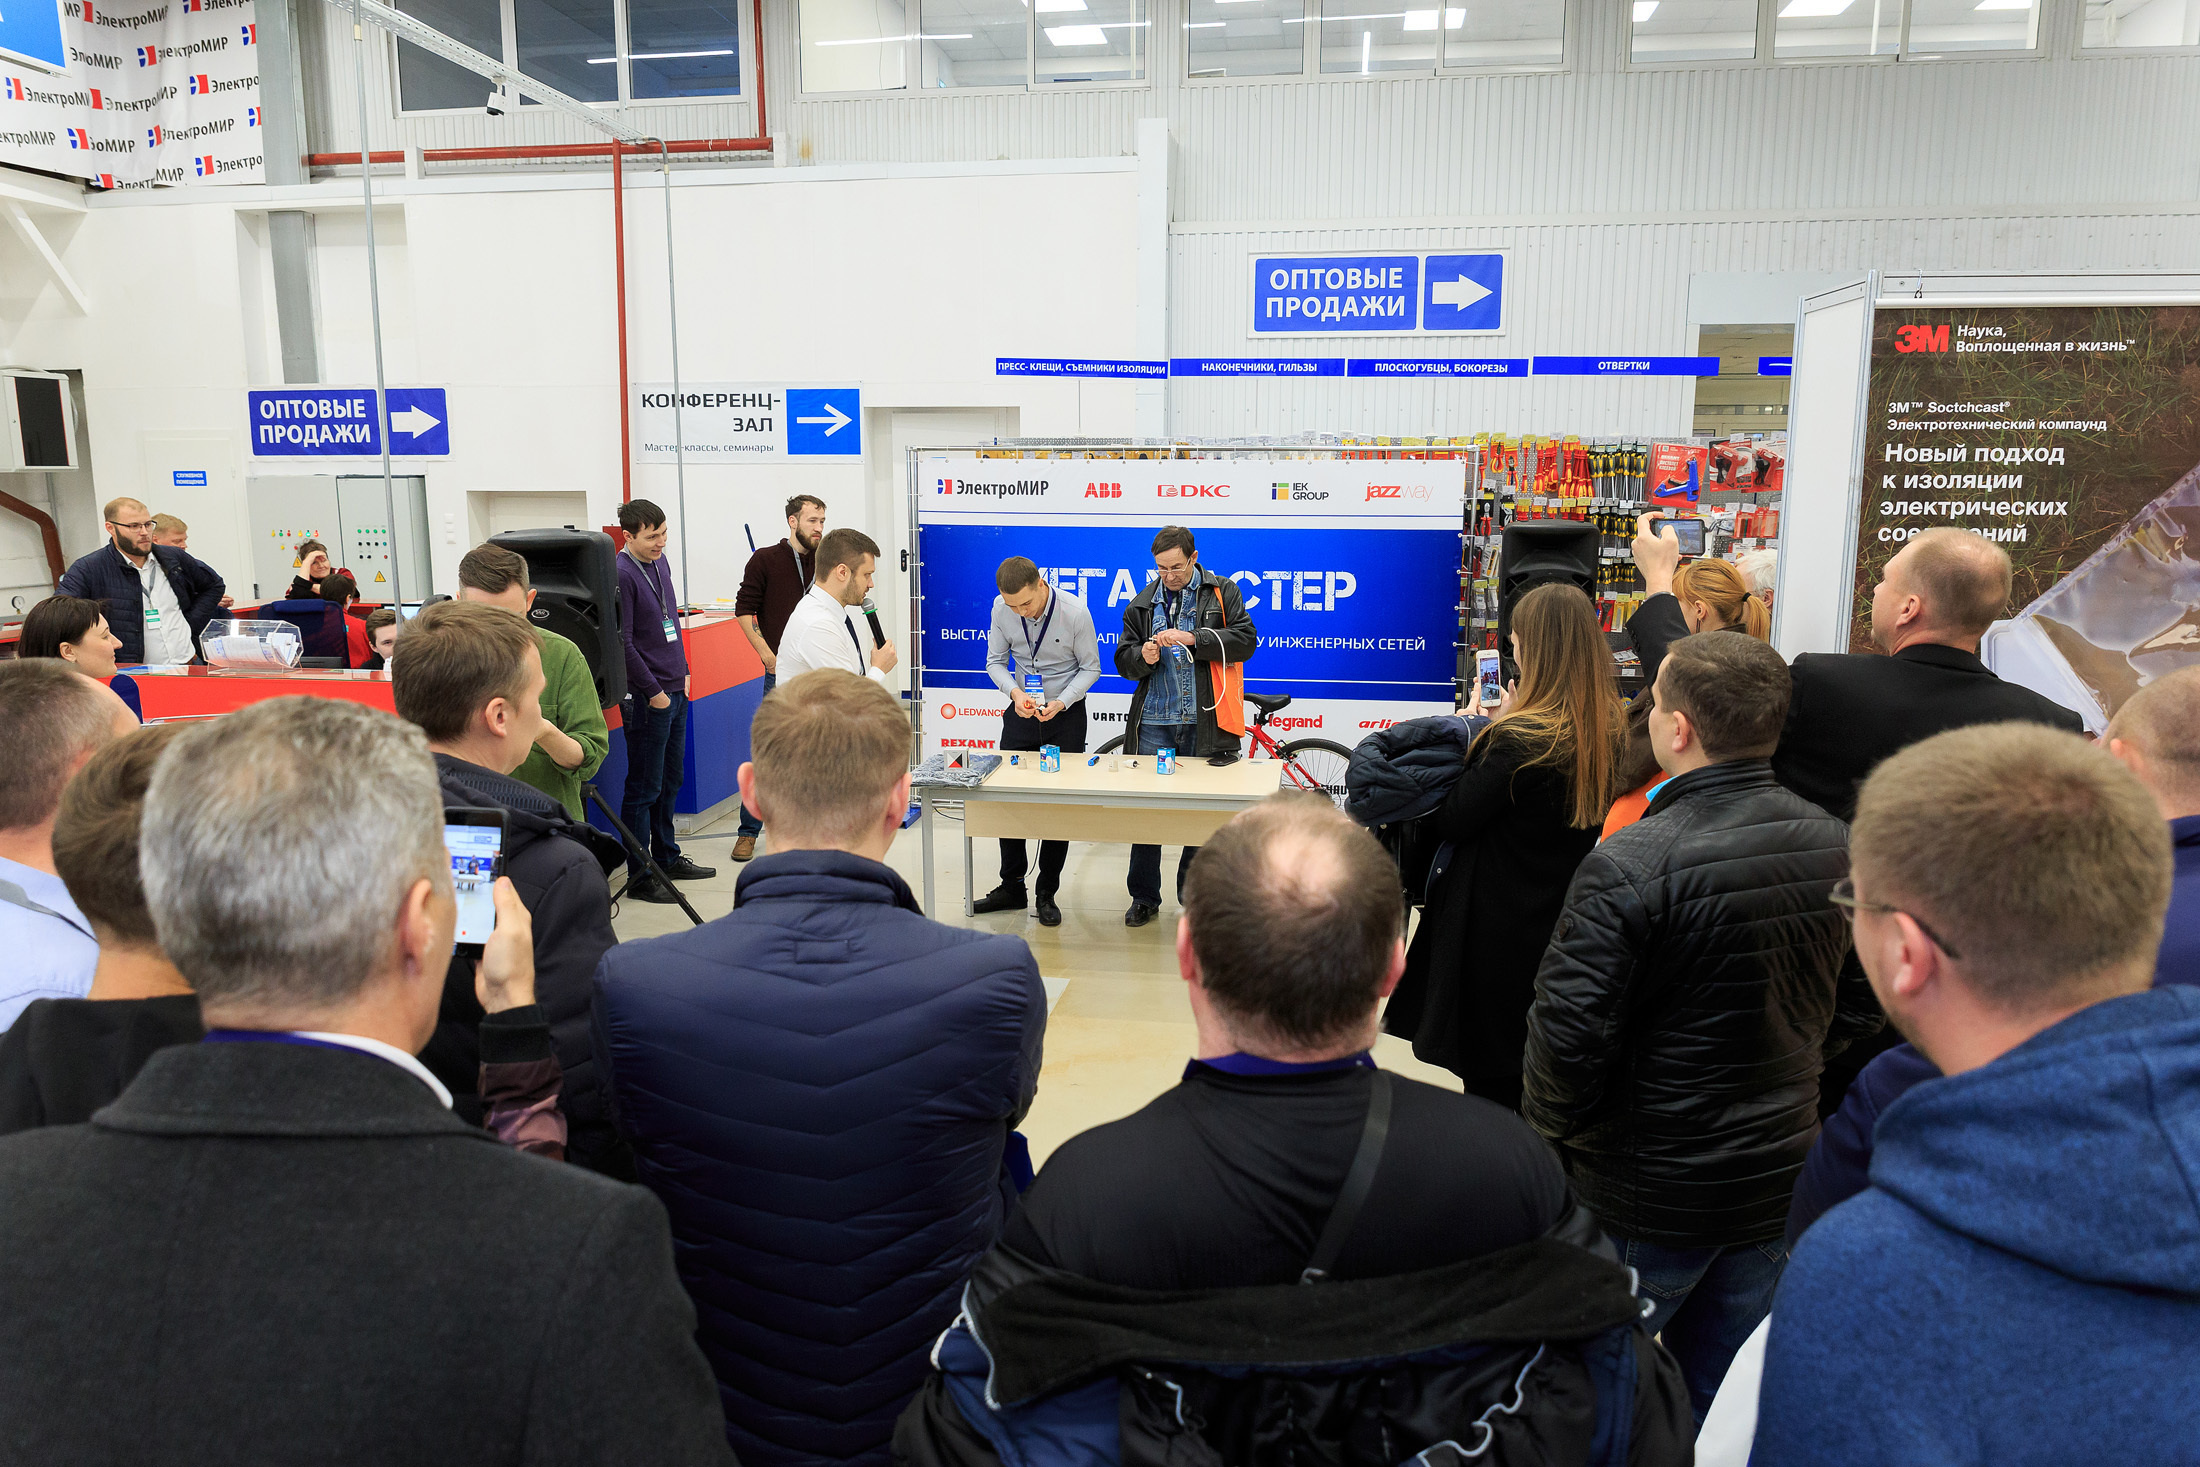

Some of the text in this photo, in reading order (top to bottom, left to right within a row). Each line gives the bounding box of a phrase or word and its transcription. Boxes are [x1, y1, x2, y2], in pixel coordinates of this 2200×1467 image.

[204, 0, 254, 11] Электр
[162, 118, 235, 141] ЭлектроМИР
[1269, 267, 1404, 291] ОПТОВЫЕ
[1266, 295, 1406, 322] ПРОДАЖИ
[1894, 324, 1950, 354] 3M
[1957, 324, 2008, 339] Наука,
[1955, 340, 2062, 354] Воплощенная
[2064, 342, 2074, 352] в
[998, 362, 1167, 375] ПРЕСС- КЛЕЩИ, СЪЕМНИКИ ИЗОЛЯЦИИ
[1201, 362, 1318, 374] НАКОНЕЧНИКИ, ГИЛЬЗЫ
[1374, 363, 1508, 374] ПЛОСКОГУБЦЫ, БОКОРЕЗЫ
[1598, 361, 1650, 371] ОТВЕРТКИ
[259, 398, 367, 420] ОПТОВЫЕ
[641, 392, 781, 411] КОНФЕРЕНЦ-
[732, 417, 774, 432] ЗАЛ
[1887, 418, 2108, 431] Электротехнический компаунд
[259, 424, 372, 448] ПРОДАЖИ
[644, 443, 774, 454] Мастер-классы, семинары
[1884, 443, 2066, 465] Новый подход
[956, 479, 1050, 499] ЭлектроМИР
[1084, 482, 1123, 499] ABB
[1180, 484, 1231, 498] DKC
[1292, 482, 1308, 491] IEK
[1882, 474, 2023, 492] к изоляции
[1292, 491, 1330, 501] GROUP
[1364, 481, 1435, 502] jazzway
[1880, 499, 2069, 520] электрических
[1877, 523, 2028, 542] соений
[1268, 636, 1375, 650] ИНЖЕНЕРНЫХ
[1378, 635, 1426, 651] СЕТЕЙ
[1268, 713, 1323, 732] legrand
[940, 738, 996, 749] REXANT
